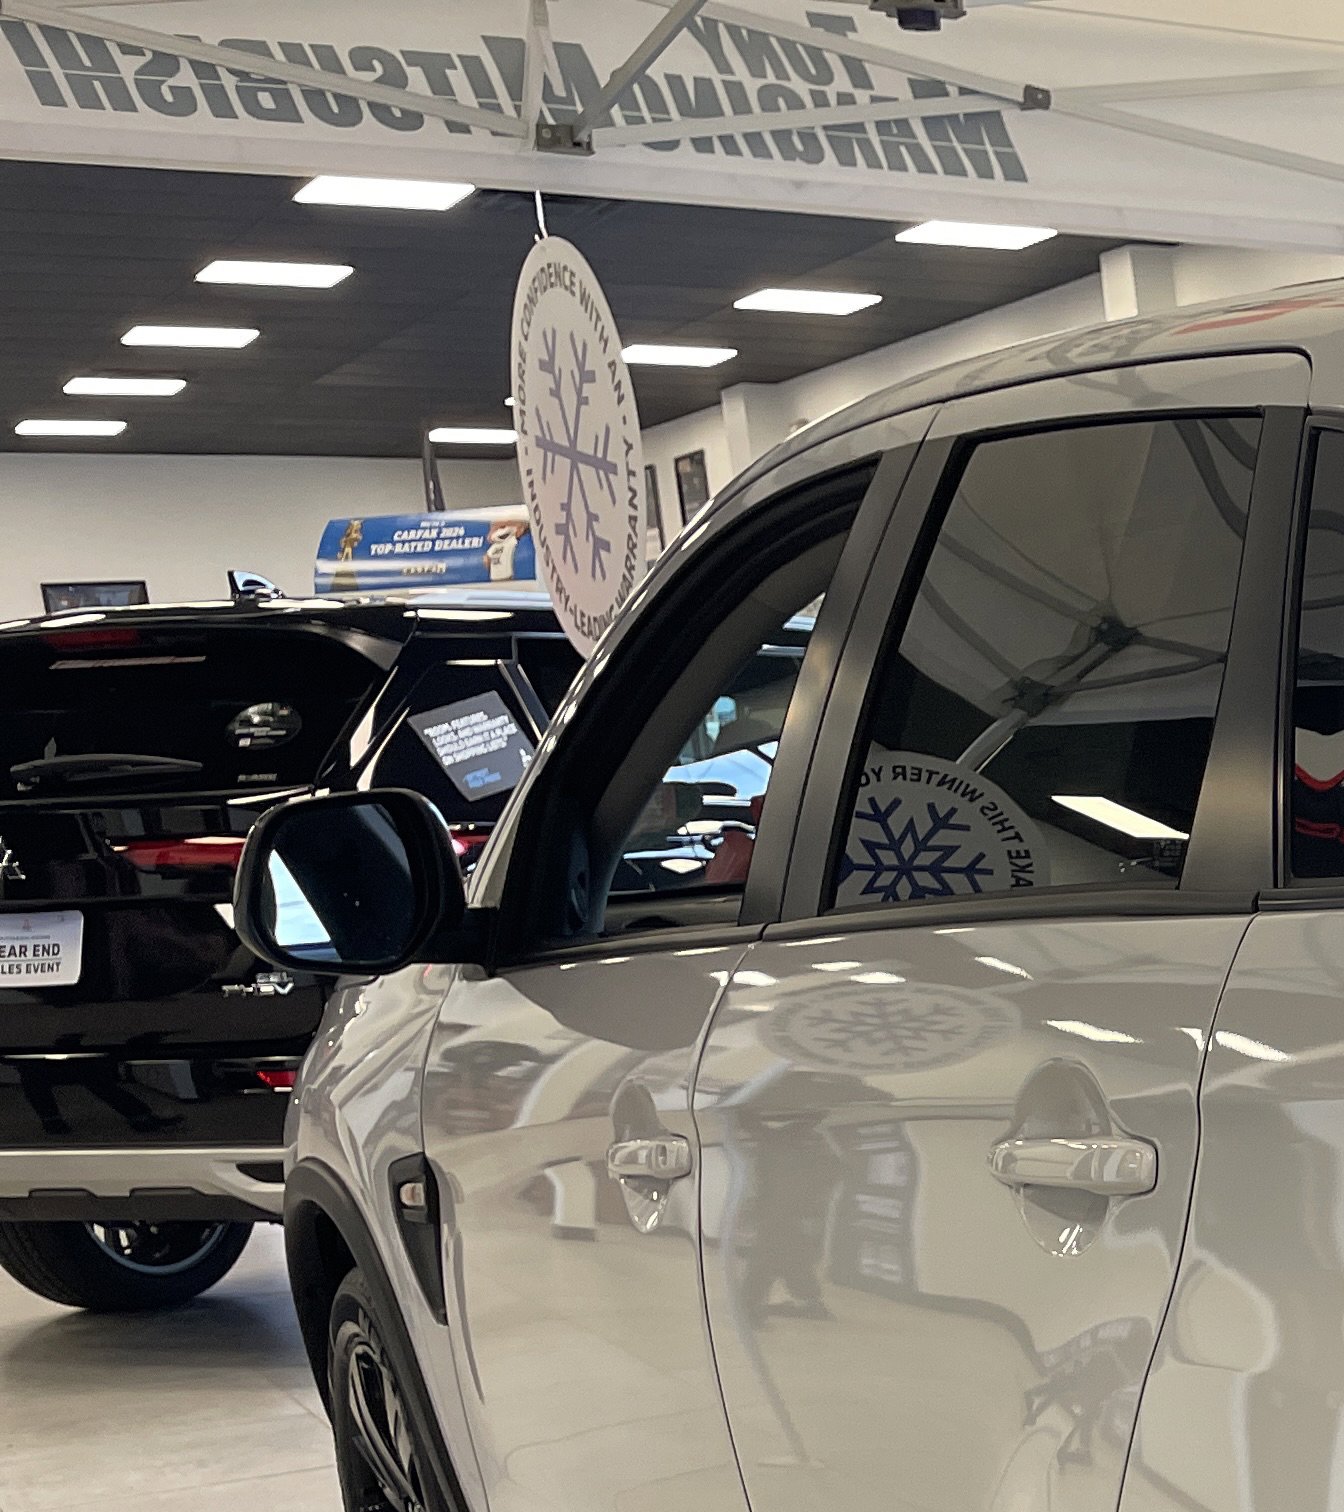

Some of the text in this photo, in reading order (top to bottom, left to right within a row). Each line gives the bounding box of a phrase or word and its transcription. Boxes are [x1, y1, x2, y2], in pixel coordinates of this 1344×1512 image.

[517, 262, 625, 436] MORE CONFIDENCE WITH AN
[0, 943, 61, 958] EAR END
[0, 961, 62, 975] LES EVENT
